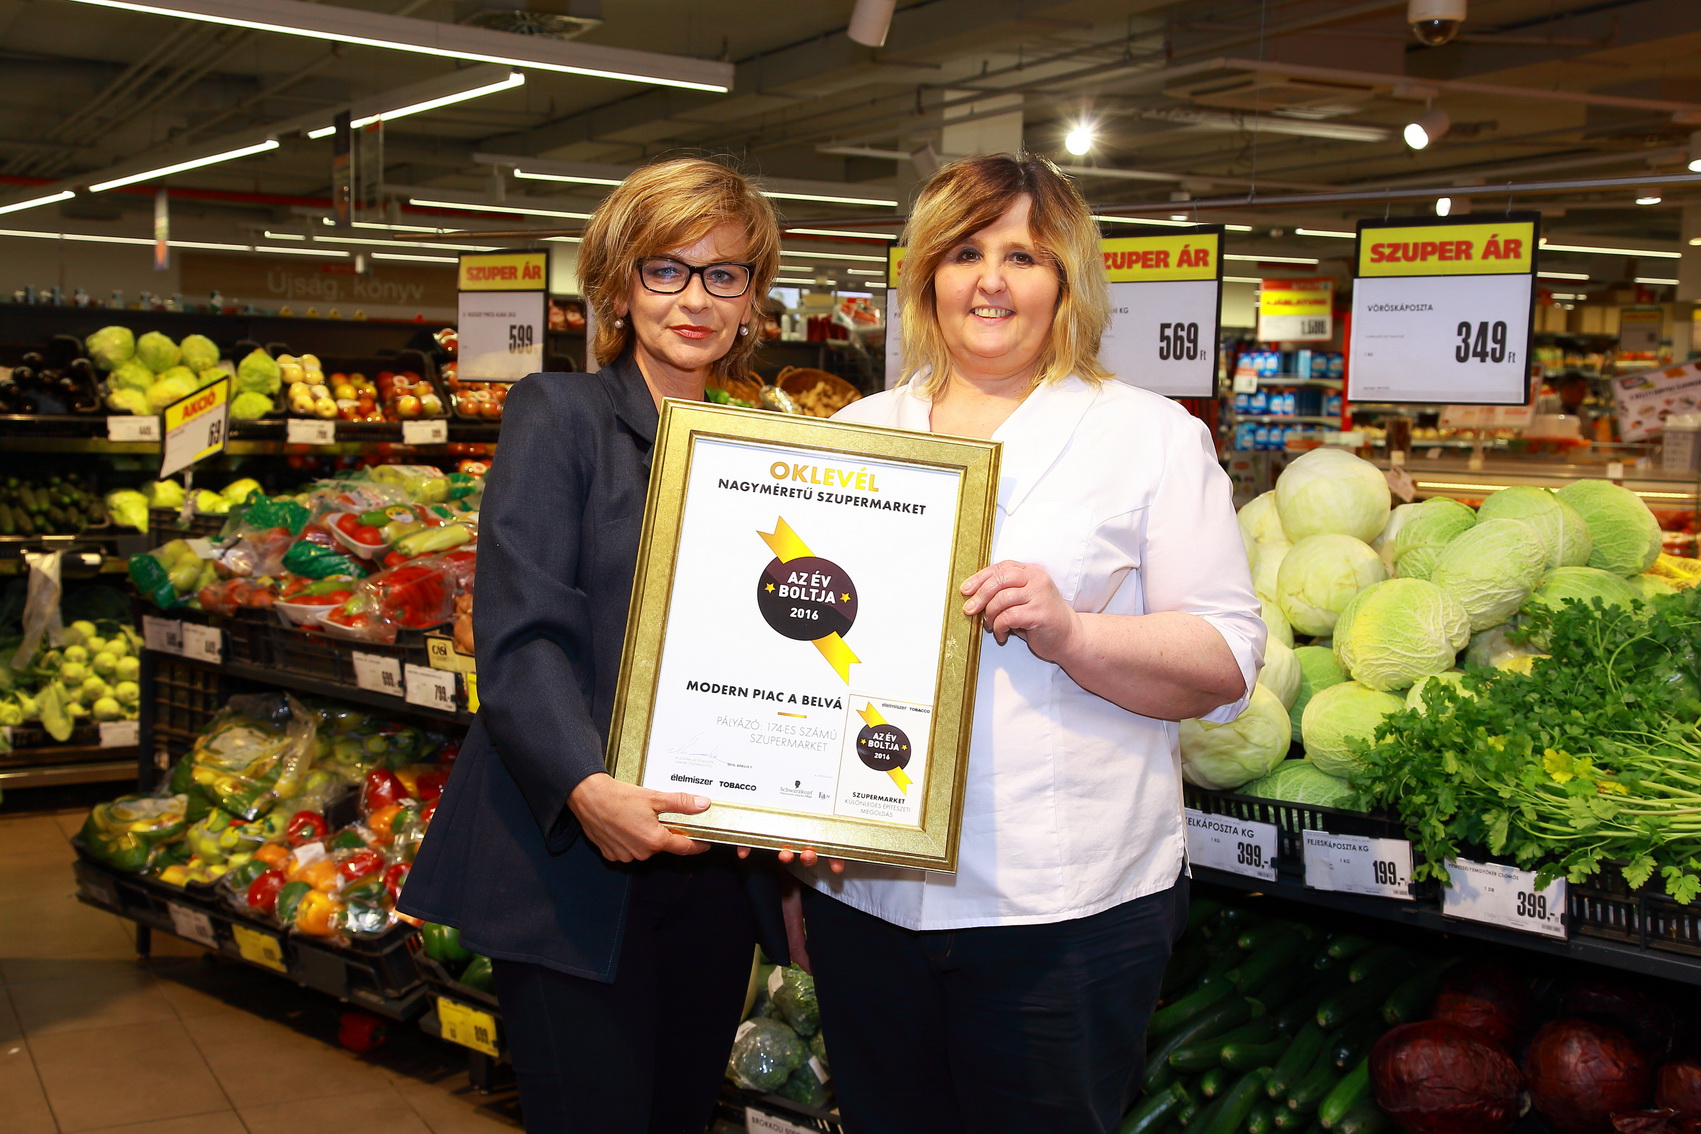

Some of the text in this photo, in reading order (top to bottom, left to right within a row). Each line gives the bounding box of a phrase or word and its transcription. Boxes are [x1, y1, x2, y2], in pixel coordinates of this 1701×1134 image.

[1102, 244, 1210, 270] ZUPER ÁR
[1370, 234, 1522, 263] SZUPER ÁR
[466, 261, 542, 281] SZUPER ÁR
[353, 277, 424, 302] könyv
[1367, 303, 1434, 312] VÖRÖSKÁPOSZTA
[508, 324, 533, 354] 599
[1159, 322, 1207, 361] 569 Ft
[1455, 321, 1516, 363] 349 Ft
[182, 388, 216, 420] AKCIÓ
[208, 418, 222, 448] 69
[769, 461, 879, 492] OKLEVÉL
[718, 478, 926, 515] NAGYMÉRETŰ SZUPERMARKET
[787, 570, 832, 588] AZ ÉV
[778, 584, 836, 604] BOLTJA
[789, 607, 819, 620] 2016
[686, 680, 843, 710] MODERN PIAC A BELVÁ
[909, 706, 931, 714] TOBACCO
[716, 715, 763, 731] PÁLYÁZÓ:
[799, 723, 838, 741] SZÁMÚ
[872, 731, 897, 742] AZ ÉV
[749, 733, 828, 752] SZUPERMARKET
[867, 740, 900, 751] BOLTJA
[873, 752, 890, 760] 2016
[670, 773, 757, 792] élelmiszer TOBACCO
[852, 791, 906, 805] SZUPERMARKET
[1241, 828, 1255, 838] KG
[1307, 838, 1357, 852] FEJESKÁPOSZTA
[1373, 860, 1405, 887] 199,-
[1517, 891, 1555, 921] 399,-
